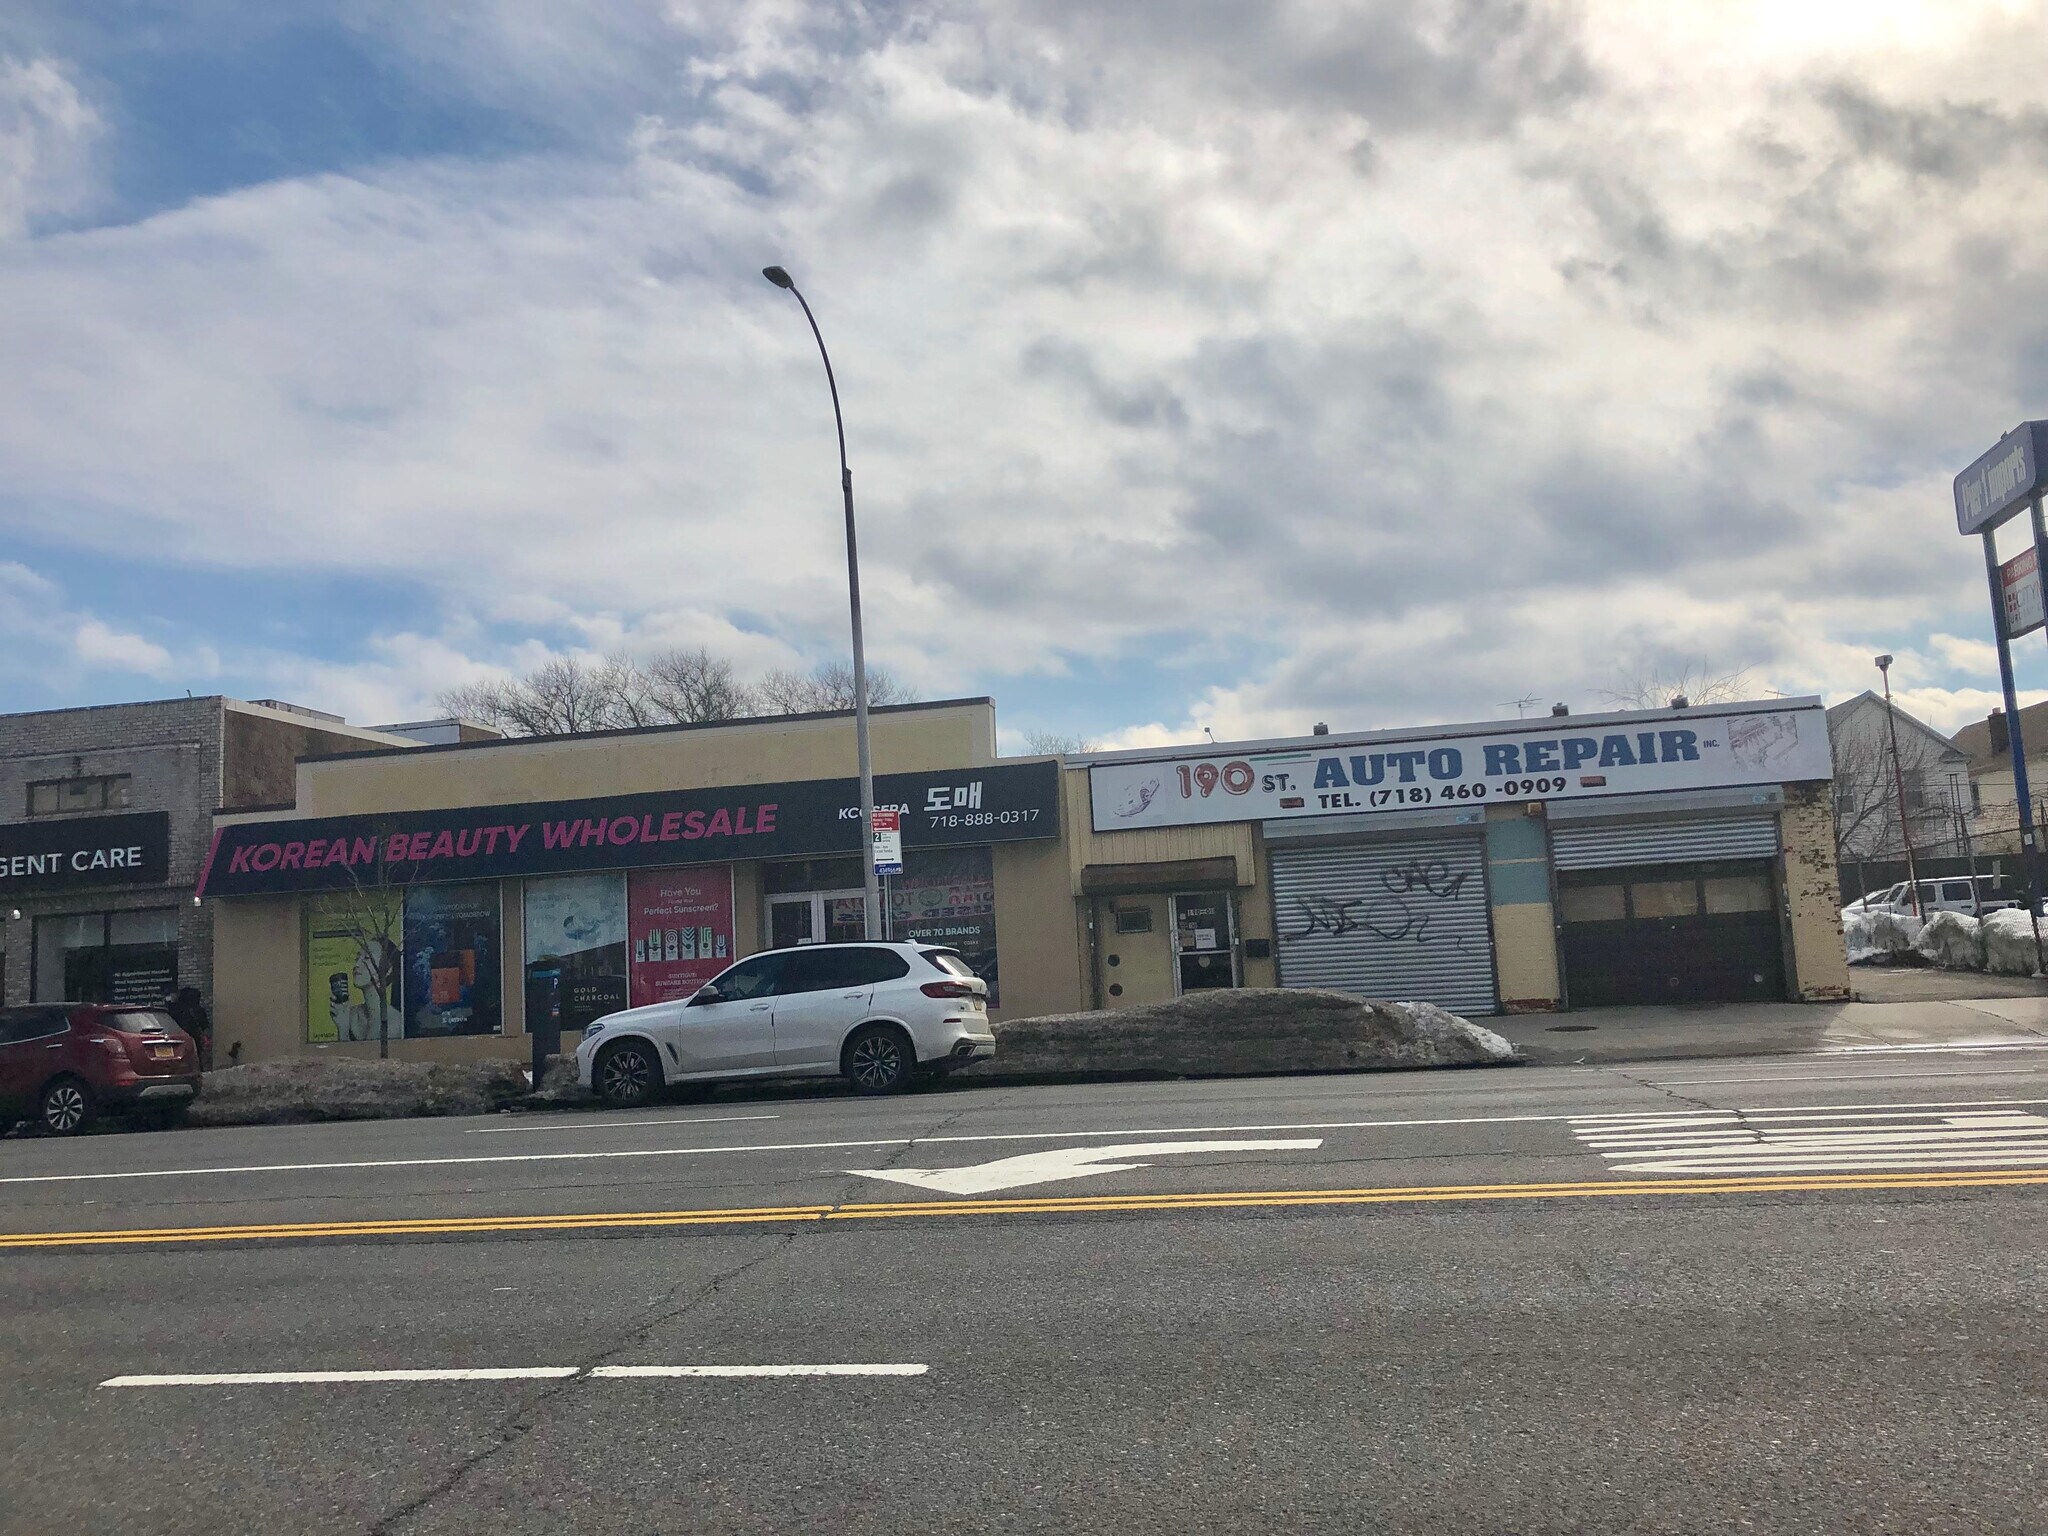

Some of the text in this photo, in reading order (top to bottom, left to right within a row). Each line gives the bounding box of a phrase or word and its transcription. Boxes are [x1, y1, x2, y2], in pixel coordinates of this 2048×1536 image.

[1962, 479, 1982, 521] Pier
[1175, 729, 1721, 799] 190 ST. AUTO REPAIR INC.
[923, 781, 983, 811] 도매
[1317, 793, 1362, 809] TEL.
[1369, 787, 1432, 807] (718)
[1440, 783, 1488, 800] 460
[929, 809, 1040, 829] 718-888-0317
[228, 803, 778, 874] KOREAN BEAUTY WHOLESALE
[874, 833, 880, 842] 2
[71, 846, 142, 872] CARE
[660, 887, 701, 897] Have You
[644, 903, 719, 915] Perfect Sunscreen?
[908, 926, 981, 938] OVER 70 BRANDS
[553, 978, 559, 989] P
[573, 986, 597, 994] GOLD
[574, 993, 620, 1002] CHARCOAL
